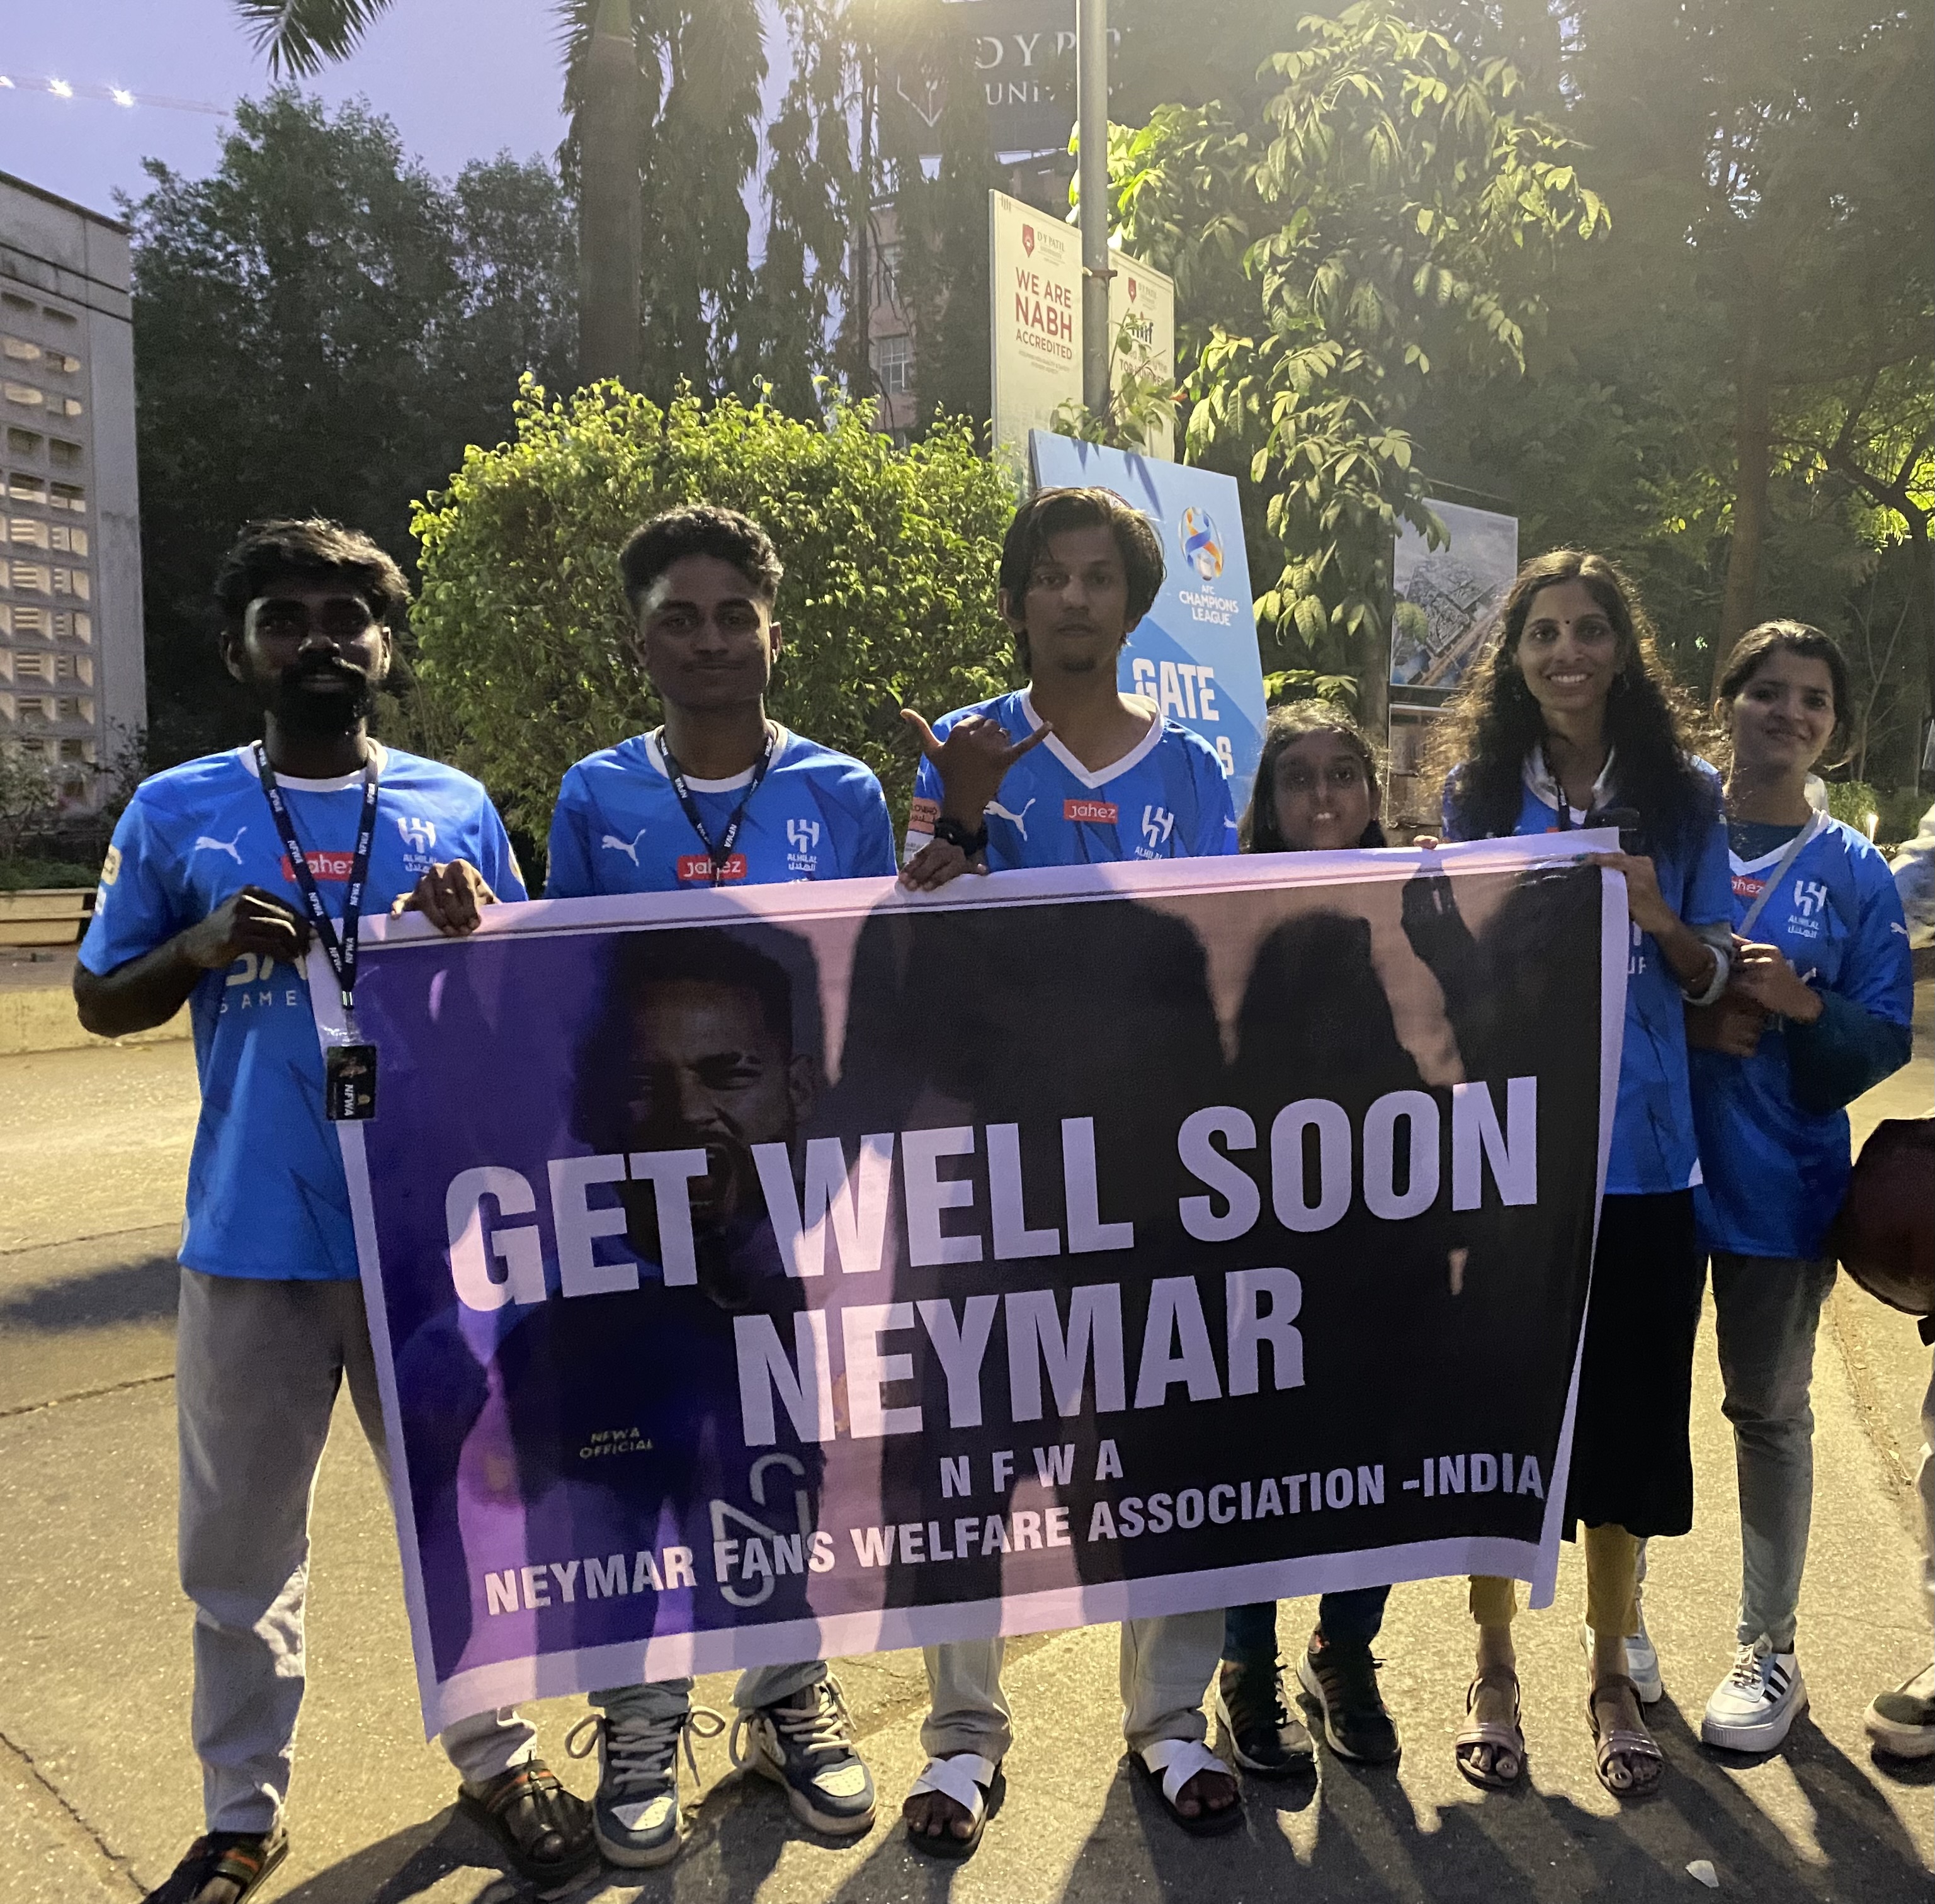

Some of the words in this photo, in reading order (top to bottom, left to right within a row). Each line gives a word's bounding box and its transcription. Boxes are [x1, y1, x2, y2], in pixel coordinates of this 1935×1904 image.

[1013, 33, 1041, 67] Y
[1048, 235, 1065, 252] PATIL
[1015, 266, 1039, 296] WE
[1044, 280, 1072, 309] ARE
[1015, 292, 1072, 343] NABH
[1016, 328, 1072, 360] ACCREDITED
[1179, 590, 1239, 614] CHAMPIONS
[1201, 584, 1216, 595] AFC
[1191, 607, 1231, 626] LEAGUE
[1132, 657, 1220, 721] GATE
[1069, 803, 1116, 819] jahez
[723, 824, 737, 847] NFWA
[344, 938, 355, 964] NFWA
[344, 1084, 355, 1117] NFWA
[445, 1148, 708, 1312] GET
[751, 1116, 1133, 1278] WELL
[1178, 1076, 1537, 1242] SOON
[733, 1267, 1305, 1447] NEYMAR
[579, 1439, 653, 1459] OFFICIAL
[484, 1546, 697, 1616] NEYMAR
[713, 1530, 836, 1583] FANS
[849, 1507, 1072, 1568] WELFARE
[1087, 1464, 1385, 1541] ASSOCIATION
